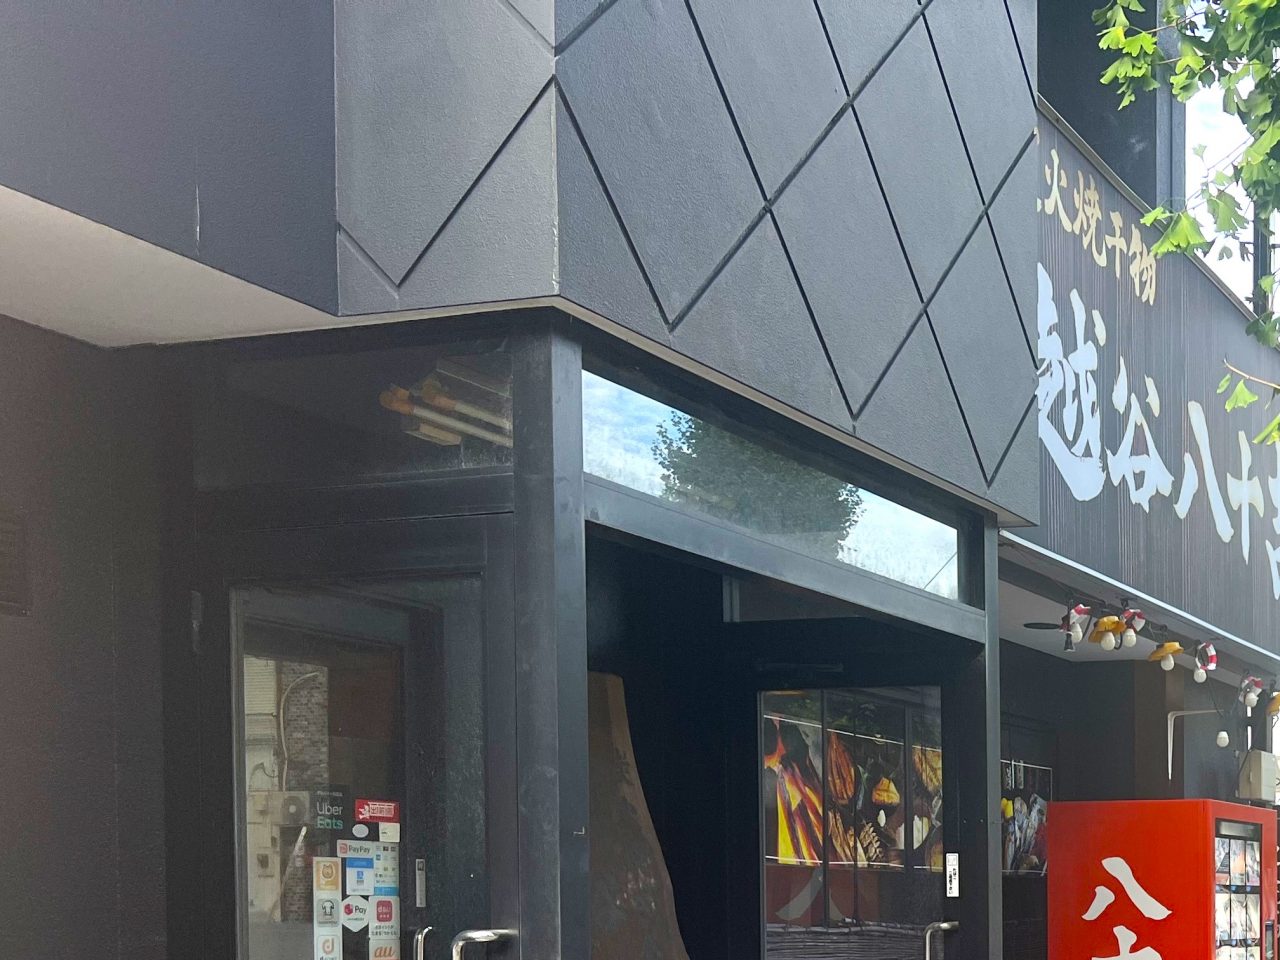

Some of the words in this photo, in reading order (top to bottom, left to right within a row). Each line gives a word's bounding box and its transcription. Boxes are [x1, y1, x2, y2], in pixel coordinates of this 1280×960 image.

[1038, 145, 1157, 306] 火焼干物
[316, 801, 344, 815] Uber
[317, 815, 344, 829] Eats
[349, 845, 371, 854] PayPay
[355, 905, 367, 914] Pay
[374, 945, 396, 958] au
